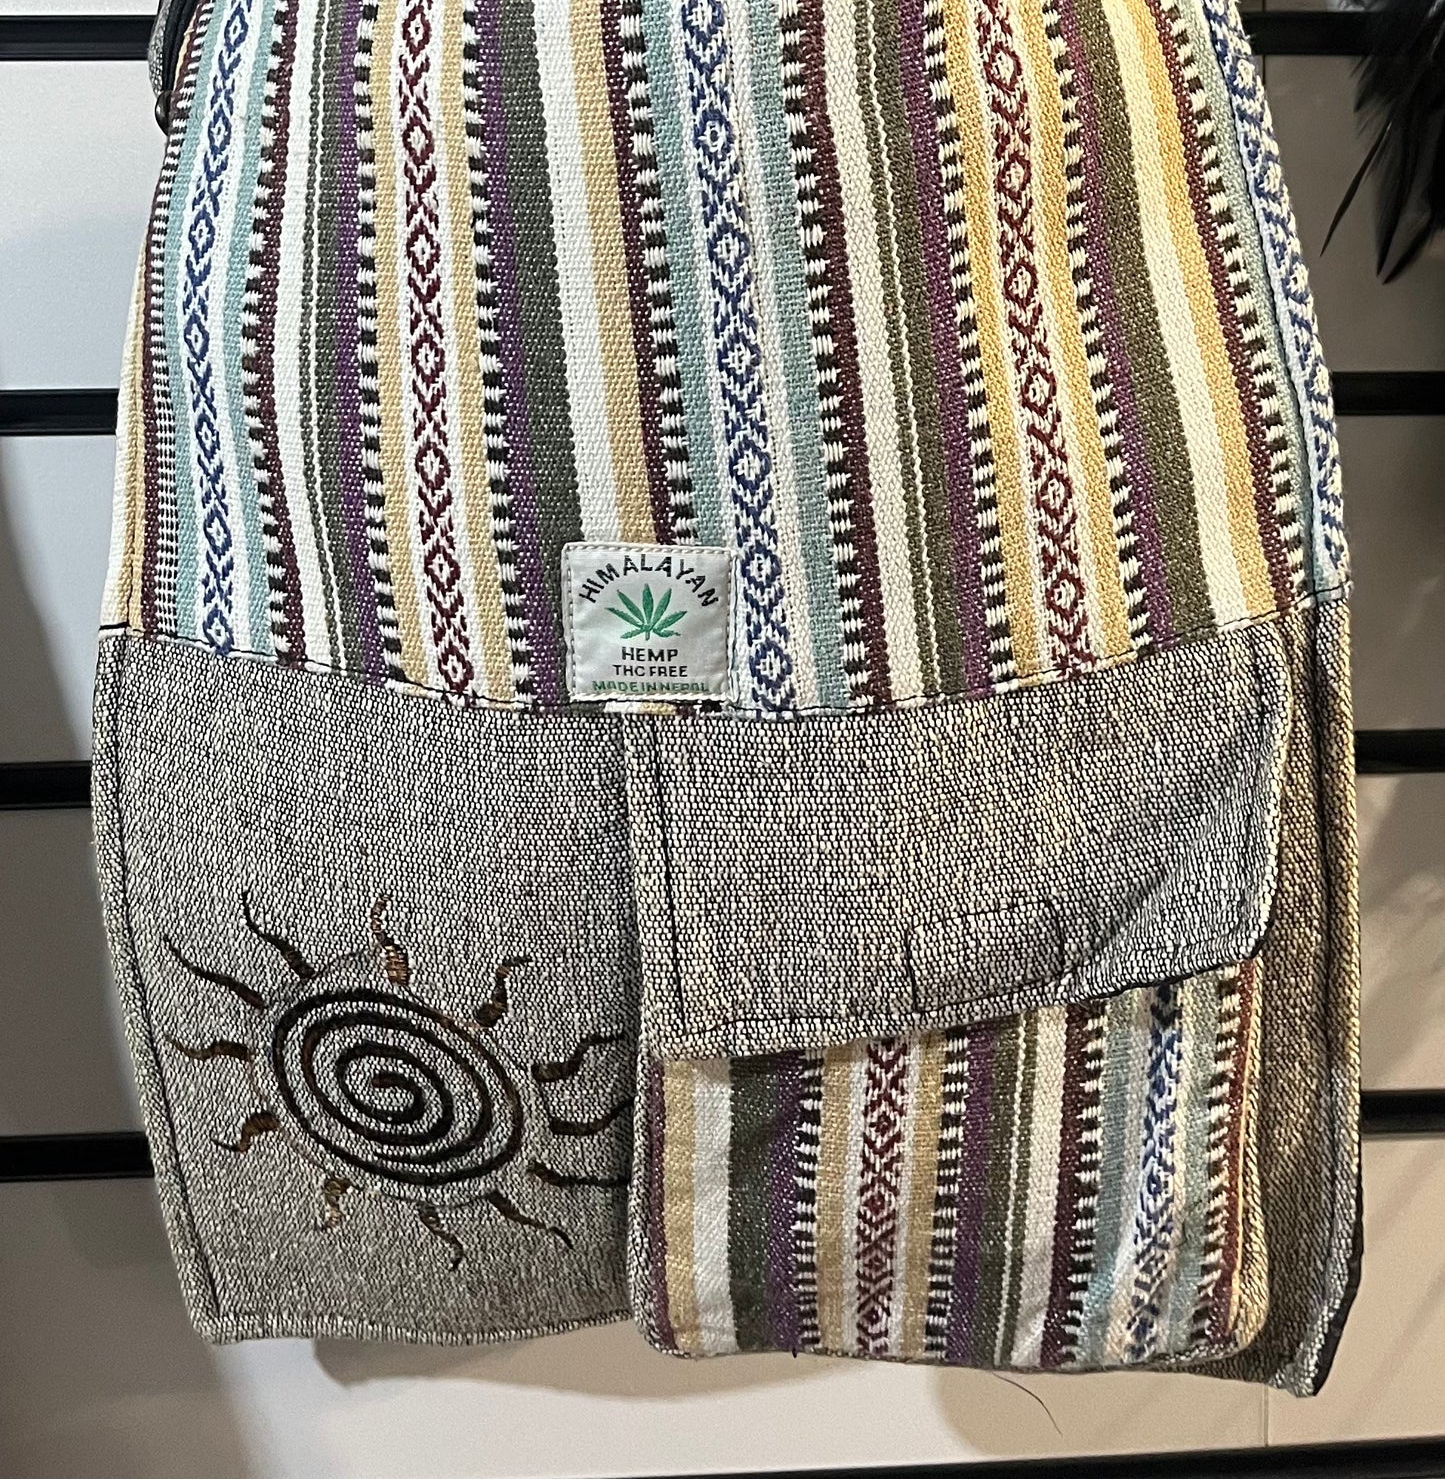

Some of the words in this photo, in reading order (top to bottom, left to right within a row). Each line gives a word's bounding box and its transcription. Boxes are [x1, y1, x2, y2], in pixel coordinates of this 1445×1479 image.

[579, 554, 719, 607] HIMALAYAN
[621, 646, 679, 662] HEMP
[612, 664, 646, 677] THC
[649, 665, 688, 677] FREE
[592, 680, 637, 692] MADE
[641, 680, 657, 692] IN
[660, 681, 710, 693] NEPAL
